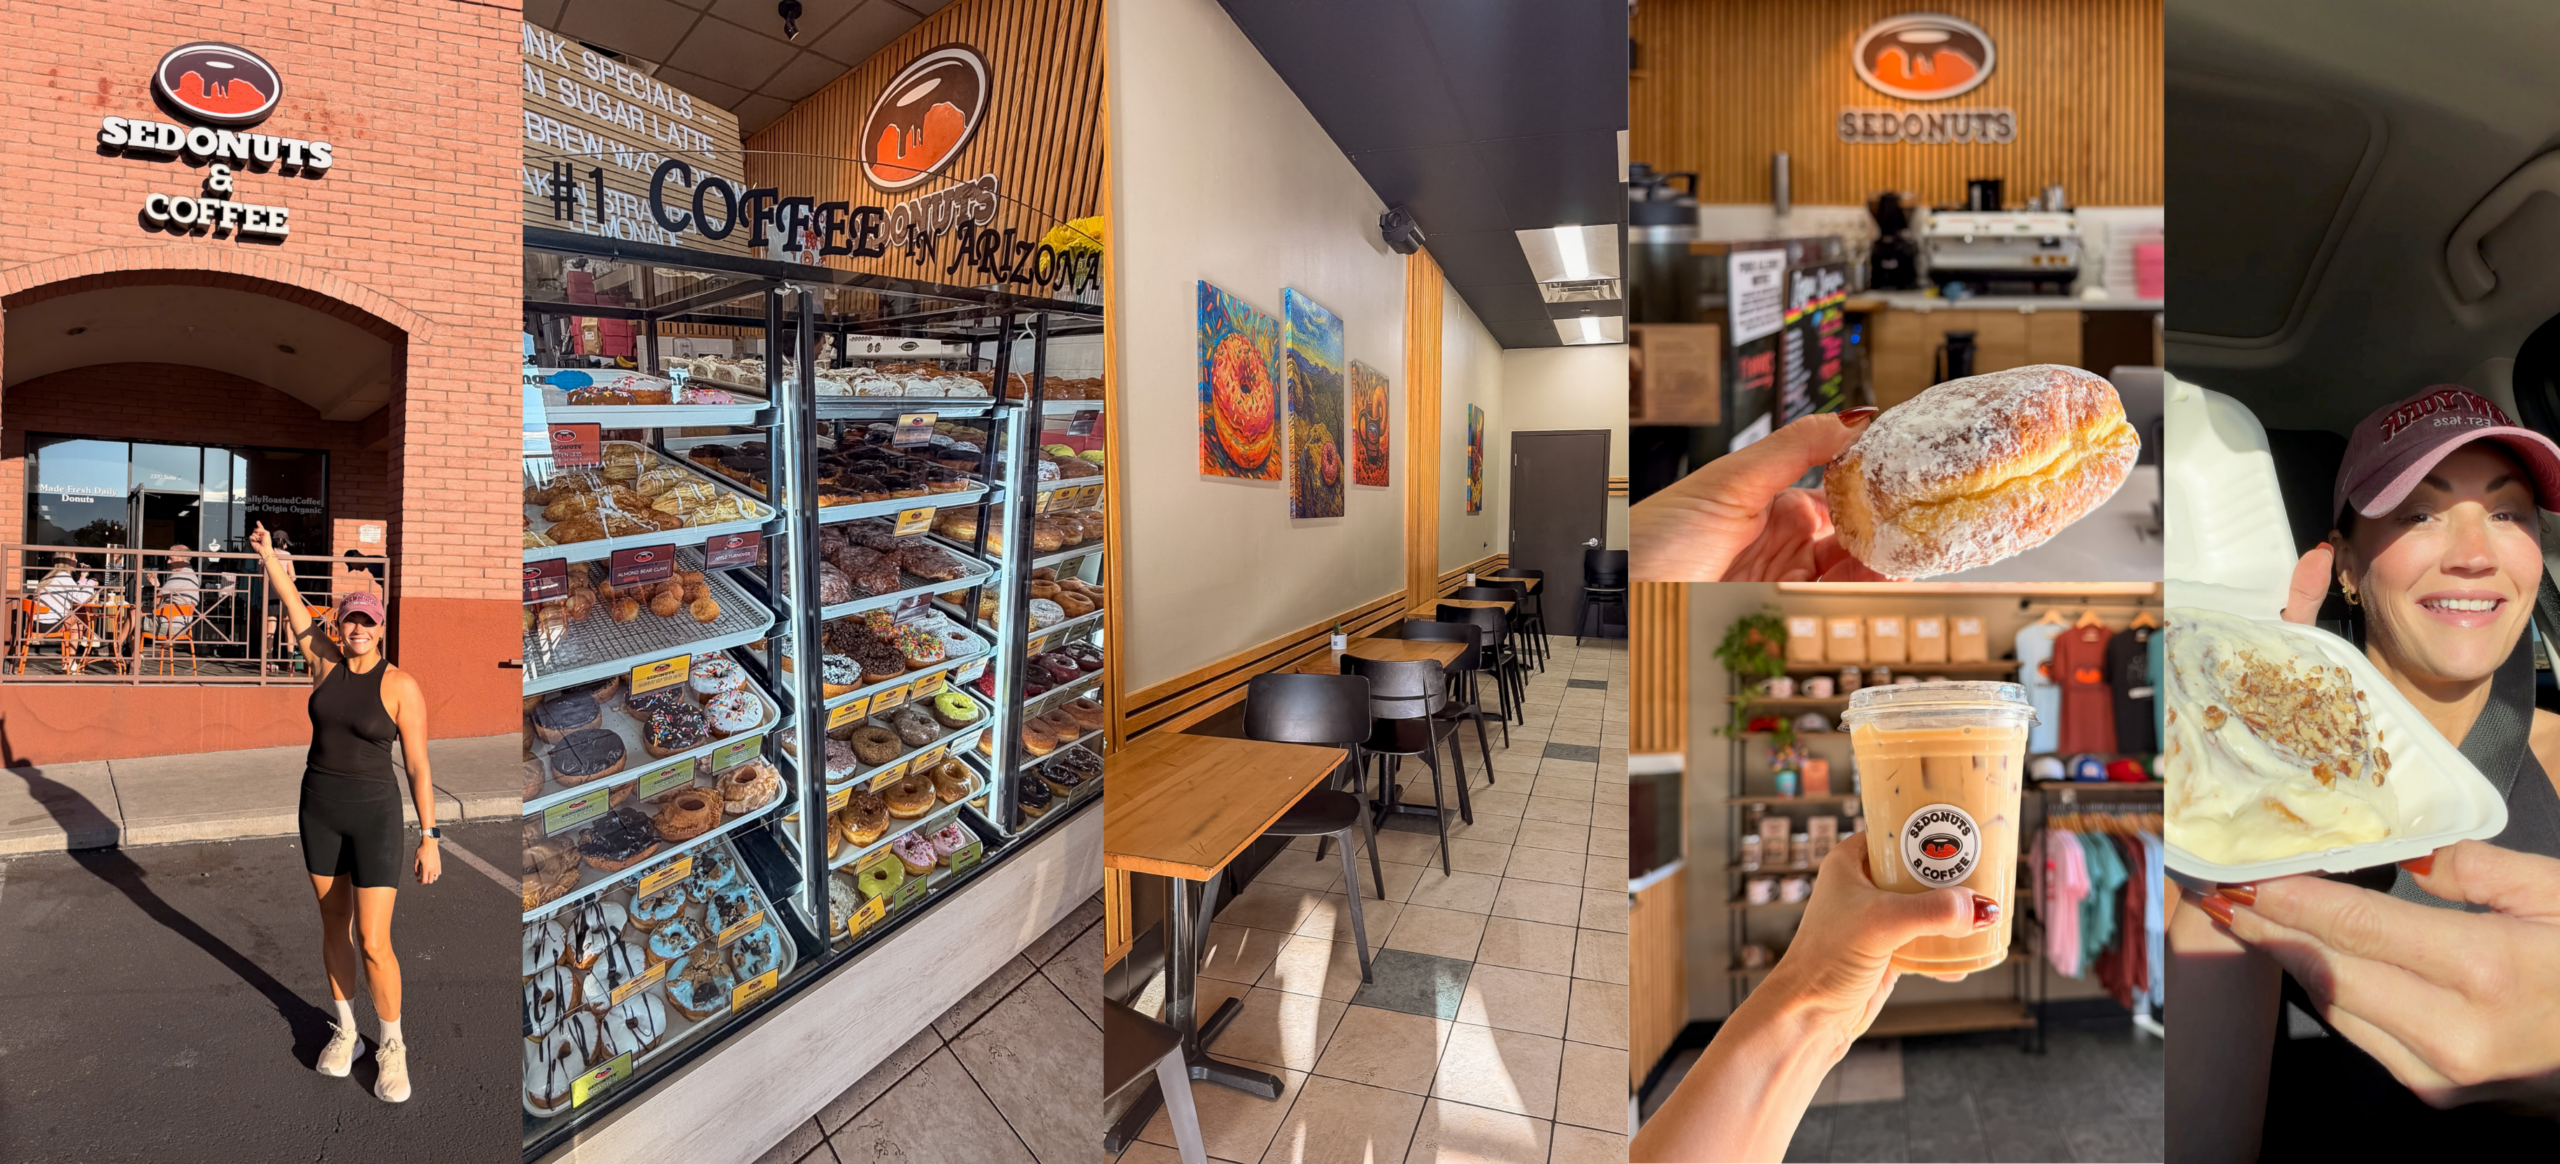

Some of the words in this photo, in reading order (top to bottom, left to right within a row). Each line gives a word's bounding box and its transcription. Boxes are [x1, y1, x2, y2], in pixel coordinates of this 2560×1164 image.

[582, 50, 693, 119] SPECIALS
[524, 110, 603, 160] BREW
[558, 77, 646, 135] SUGAR
[653, 114, 716, 159] LATTE
[1838, 107, 2016, 143] SEDONUTS
[101, 116, 333, 171] SEDONUTS
[208, 163, 233, 194] &
[145, 192, 289, 237] COFFEE
[549, 161, 605, 225] #1
[649, 158, 889, 259] COFFEE
[906, 223, 943, 267] IN
[946, 219, 1101, 295] ARIZONA
[40, 483, 65, 493] Made
[67, 485, 92, 495] Fresh
[94, 486, 118, 497] Daily
[61, 494, 95, 504] Donuts
[261, 504, 288, 514] Origin
[290, 505, 323, 515] Organic
[1909, 811, 1971, 839] SEDONUTS
[1913, 858, 1923, 869] &
[1922, 856, 1971, 880] COFFEE
